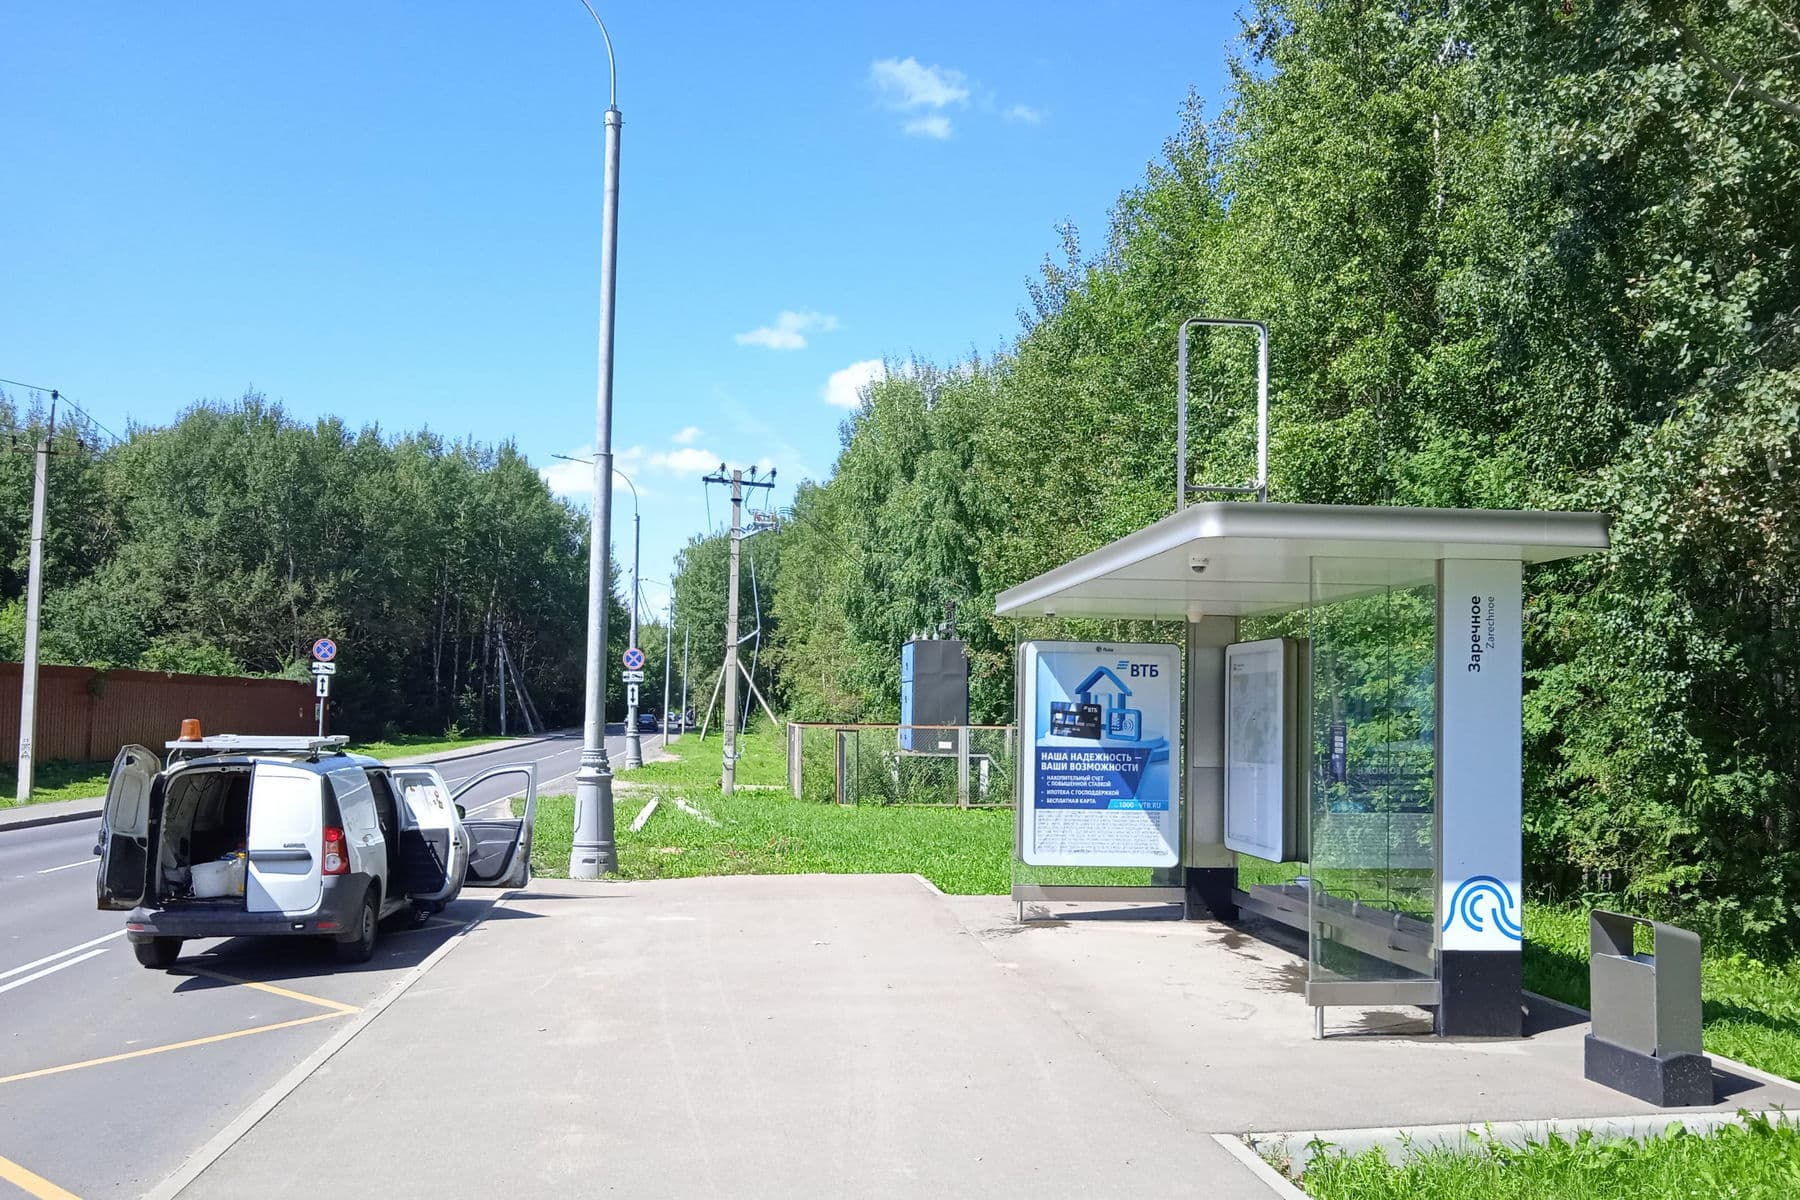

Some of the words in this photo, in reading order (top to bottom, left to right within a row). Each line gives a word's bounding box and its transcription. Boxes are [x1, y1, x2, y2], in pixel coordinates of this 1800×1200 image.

[1486, 596, 1495, 649] Zarechnoe
[1468, 595, 1483, 672] Заречное
[1131, 663, 1159, 678] ВТБ
[1041, 752, 1068, 761] НАША
[1070, 752, 1132, 763] НАДЕЖНОСТЬ
[1041, 762, 1067, 771] ВАШИ
[1070, 762, 1139, 772] ВОЗМОЖНОСТИ
[1119, 801, 1134, 809] 1000
[1139, 801, 1161, 809] VTB.RU
